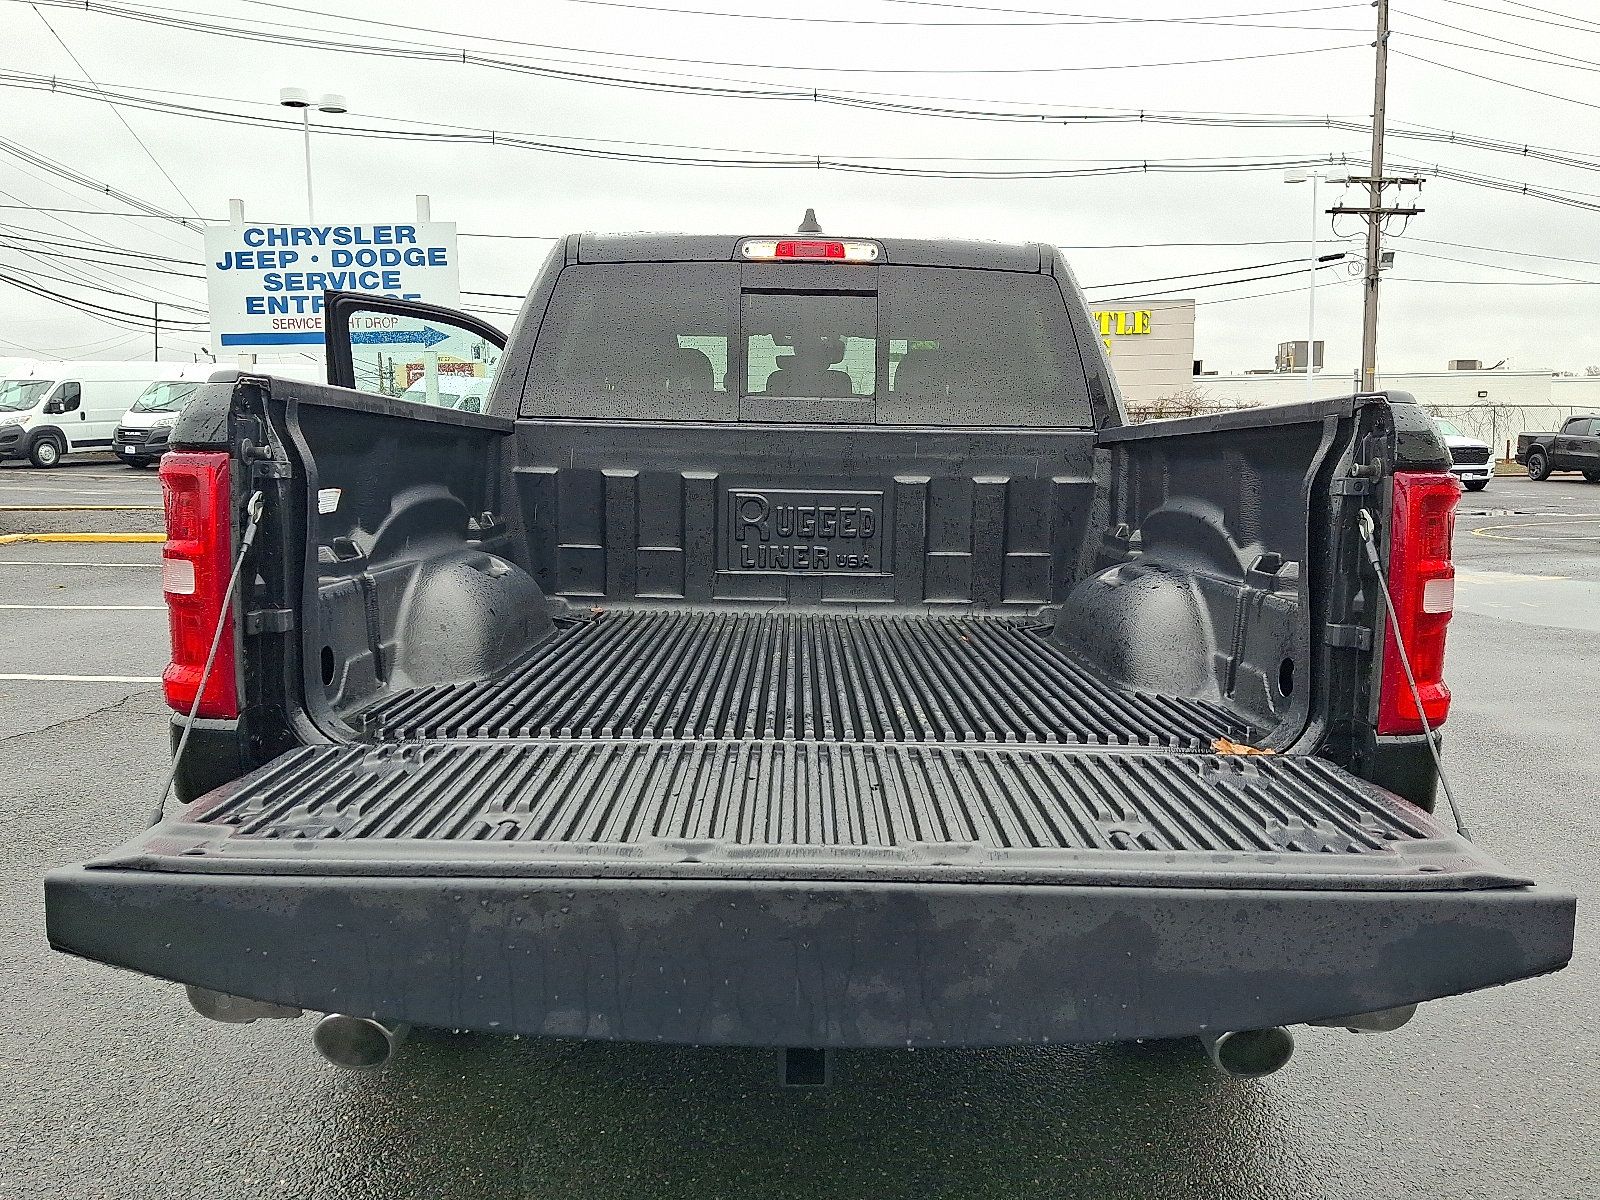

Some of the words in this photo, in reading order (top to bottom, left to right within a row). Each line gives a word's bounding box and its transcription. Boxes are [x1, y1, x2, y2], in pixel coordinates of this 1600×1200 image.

[243, 225, 417, 247] CHRYSLER
[216, 250, 299, 270] JEEP
[331, 247, 448, 268] DODGE
[263, 270, 402, 291] SERVICE
[272, 317, 322, 329] SERVICE
[365, 317, 399, 329] DROP
[1091, 310, 1152, 335] TLE
[734, 492, 876, 542] RUGGED
[740, 544, 830, 569] LINER
[835, 553, 874, 569] USA
